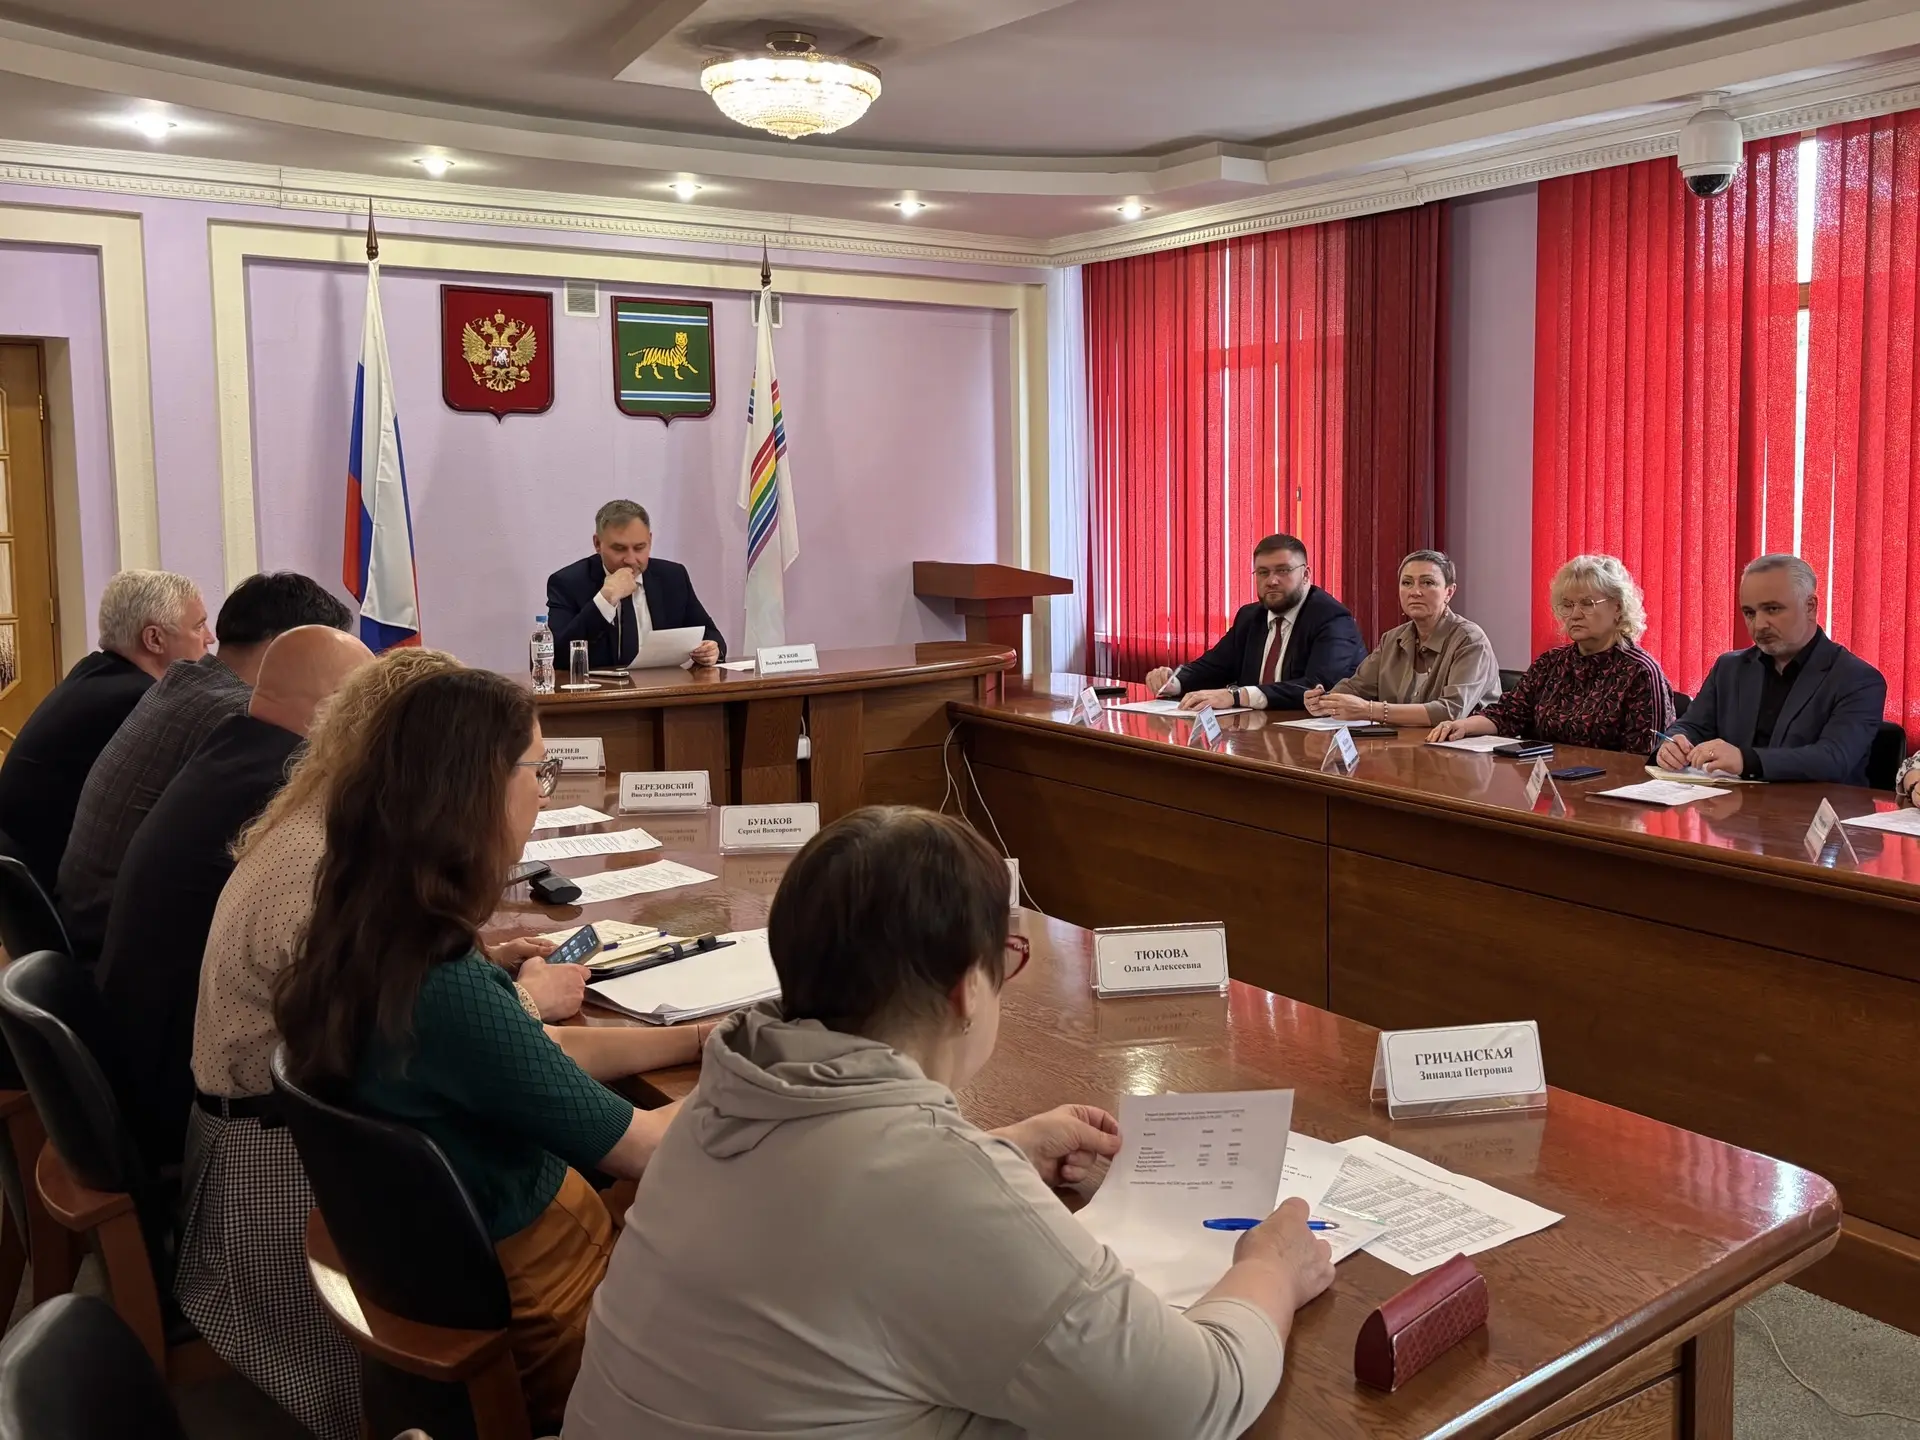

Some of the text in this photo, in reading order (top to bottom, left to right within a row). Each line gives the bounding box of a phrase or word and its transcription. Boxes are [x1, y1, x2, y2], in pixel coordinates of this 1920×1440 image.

[634, 782, 694, 790] БЕРЕЗОВСКИЙ
[747, 817, 792, 826] БУНАКОВ
[1134, 948, 1189, 960] ТЮКОВА
[1124, 962, 1202, 973] Ольга Алексеевна
[1414, 1047, 1514, 1066] ГРИЧАНСКАЯ
[1419, 1065, 1513, 1081] Зинаида Петровна
